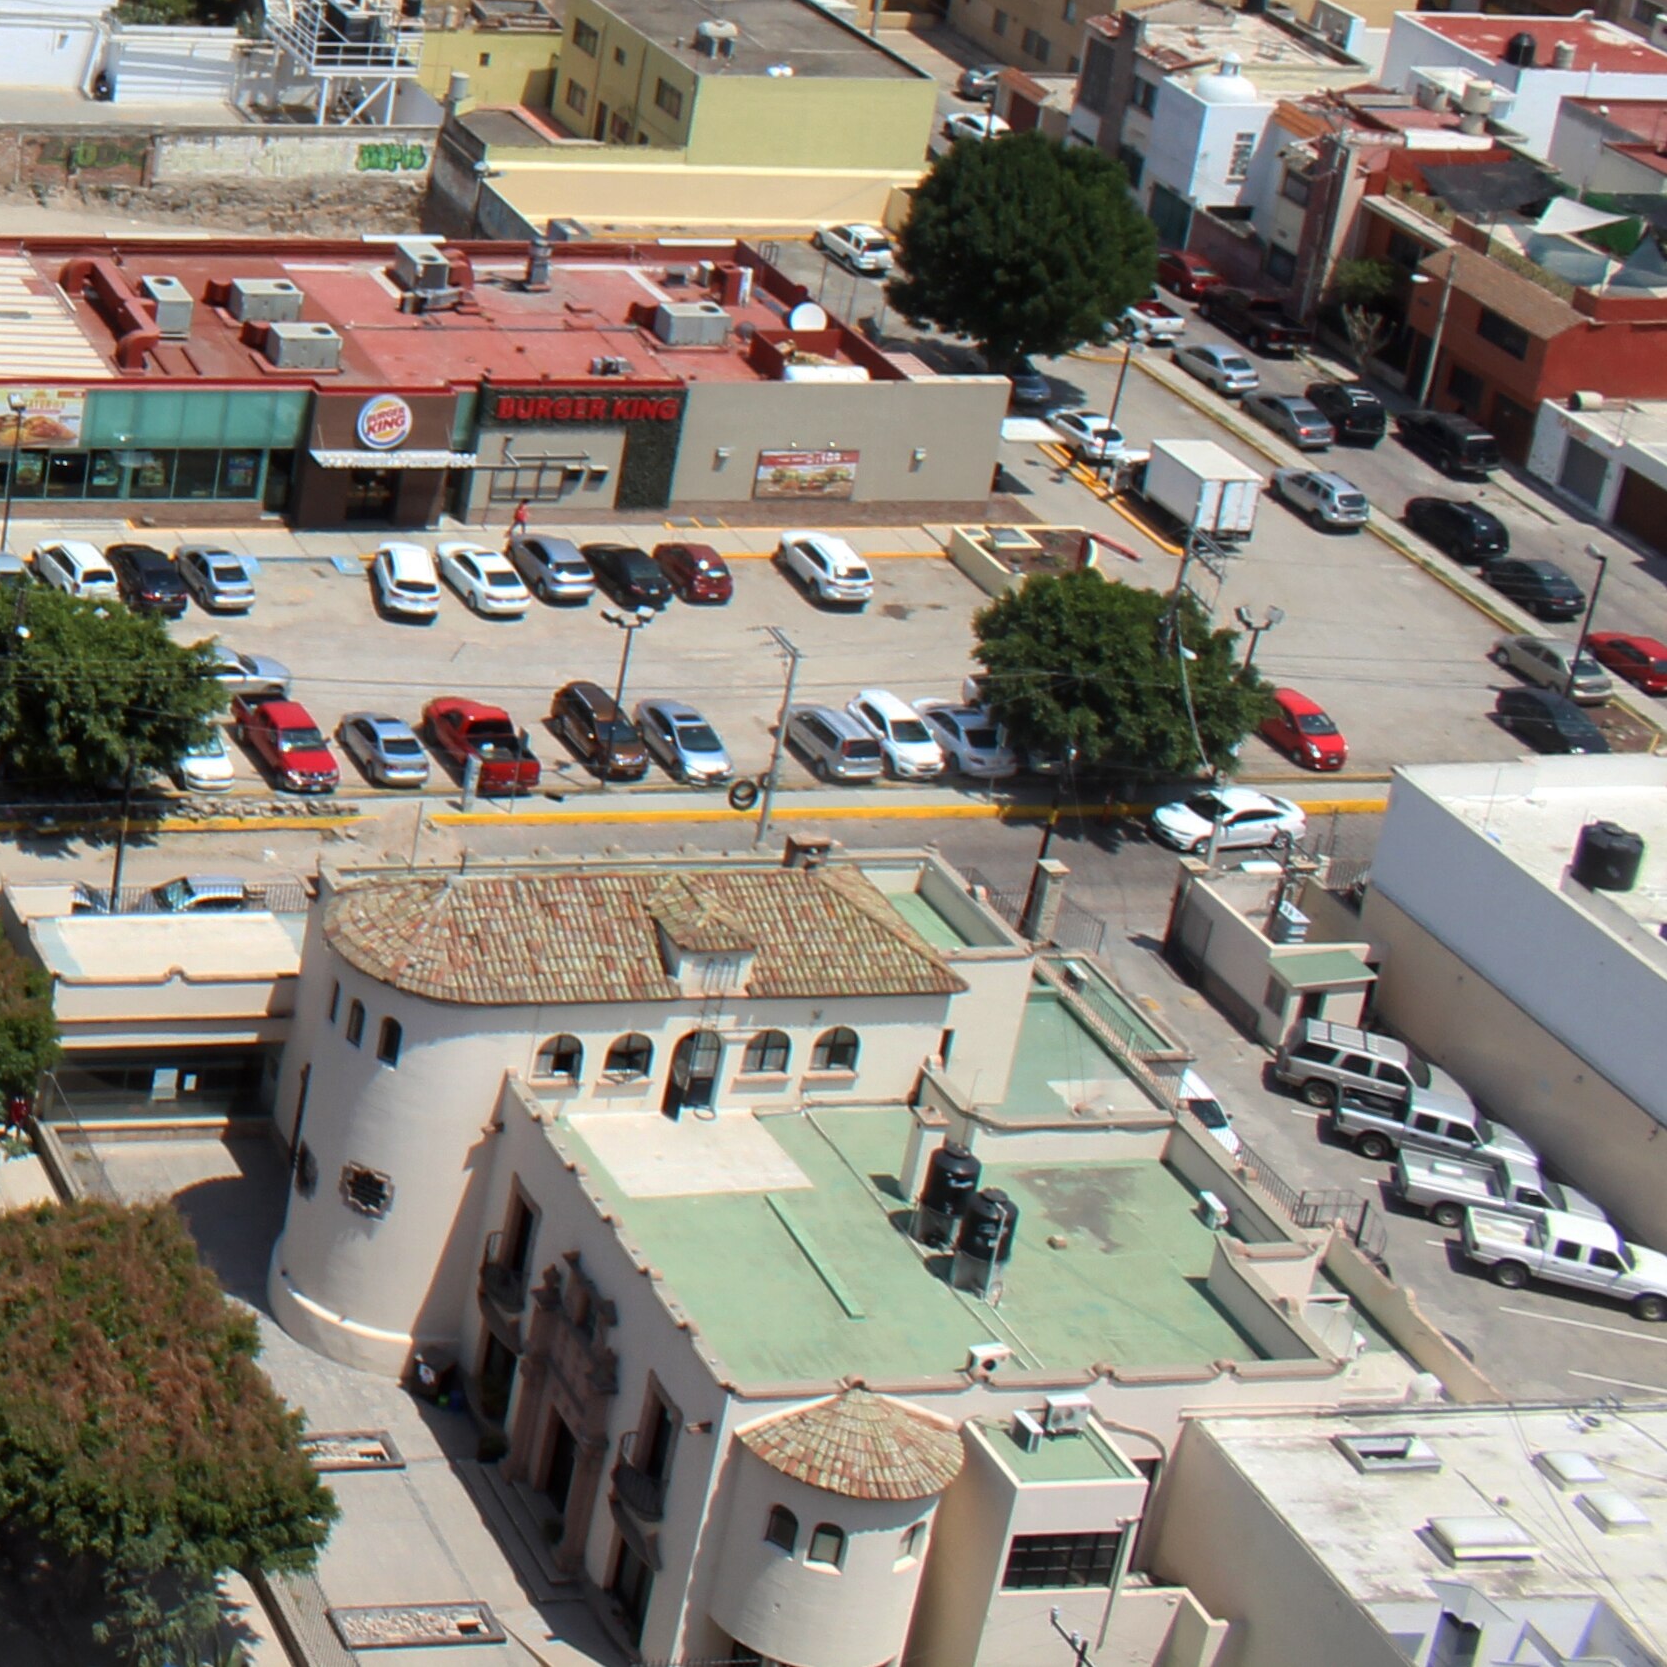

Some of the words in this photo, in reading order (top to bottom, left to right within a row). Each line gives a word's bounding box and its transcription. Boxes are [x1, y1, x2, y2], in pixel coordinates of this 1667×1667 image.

[366, 406, 406, 425] BURGER
[496, 395, 607, 420] BURGER
[611, 396, 680, 420] KING
[366, 414, 406, 437] KING
